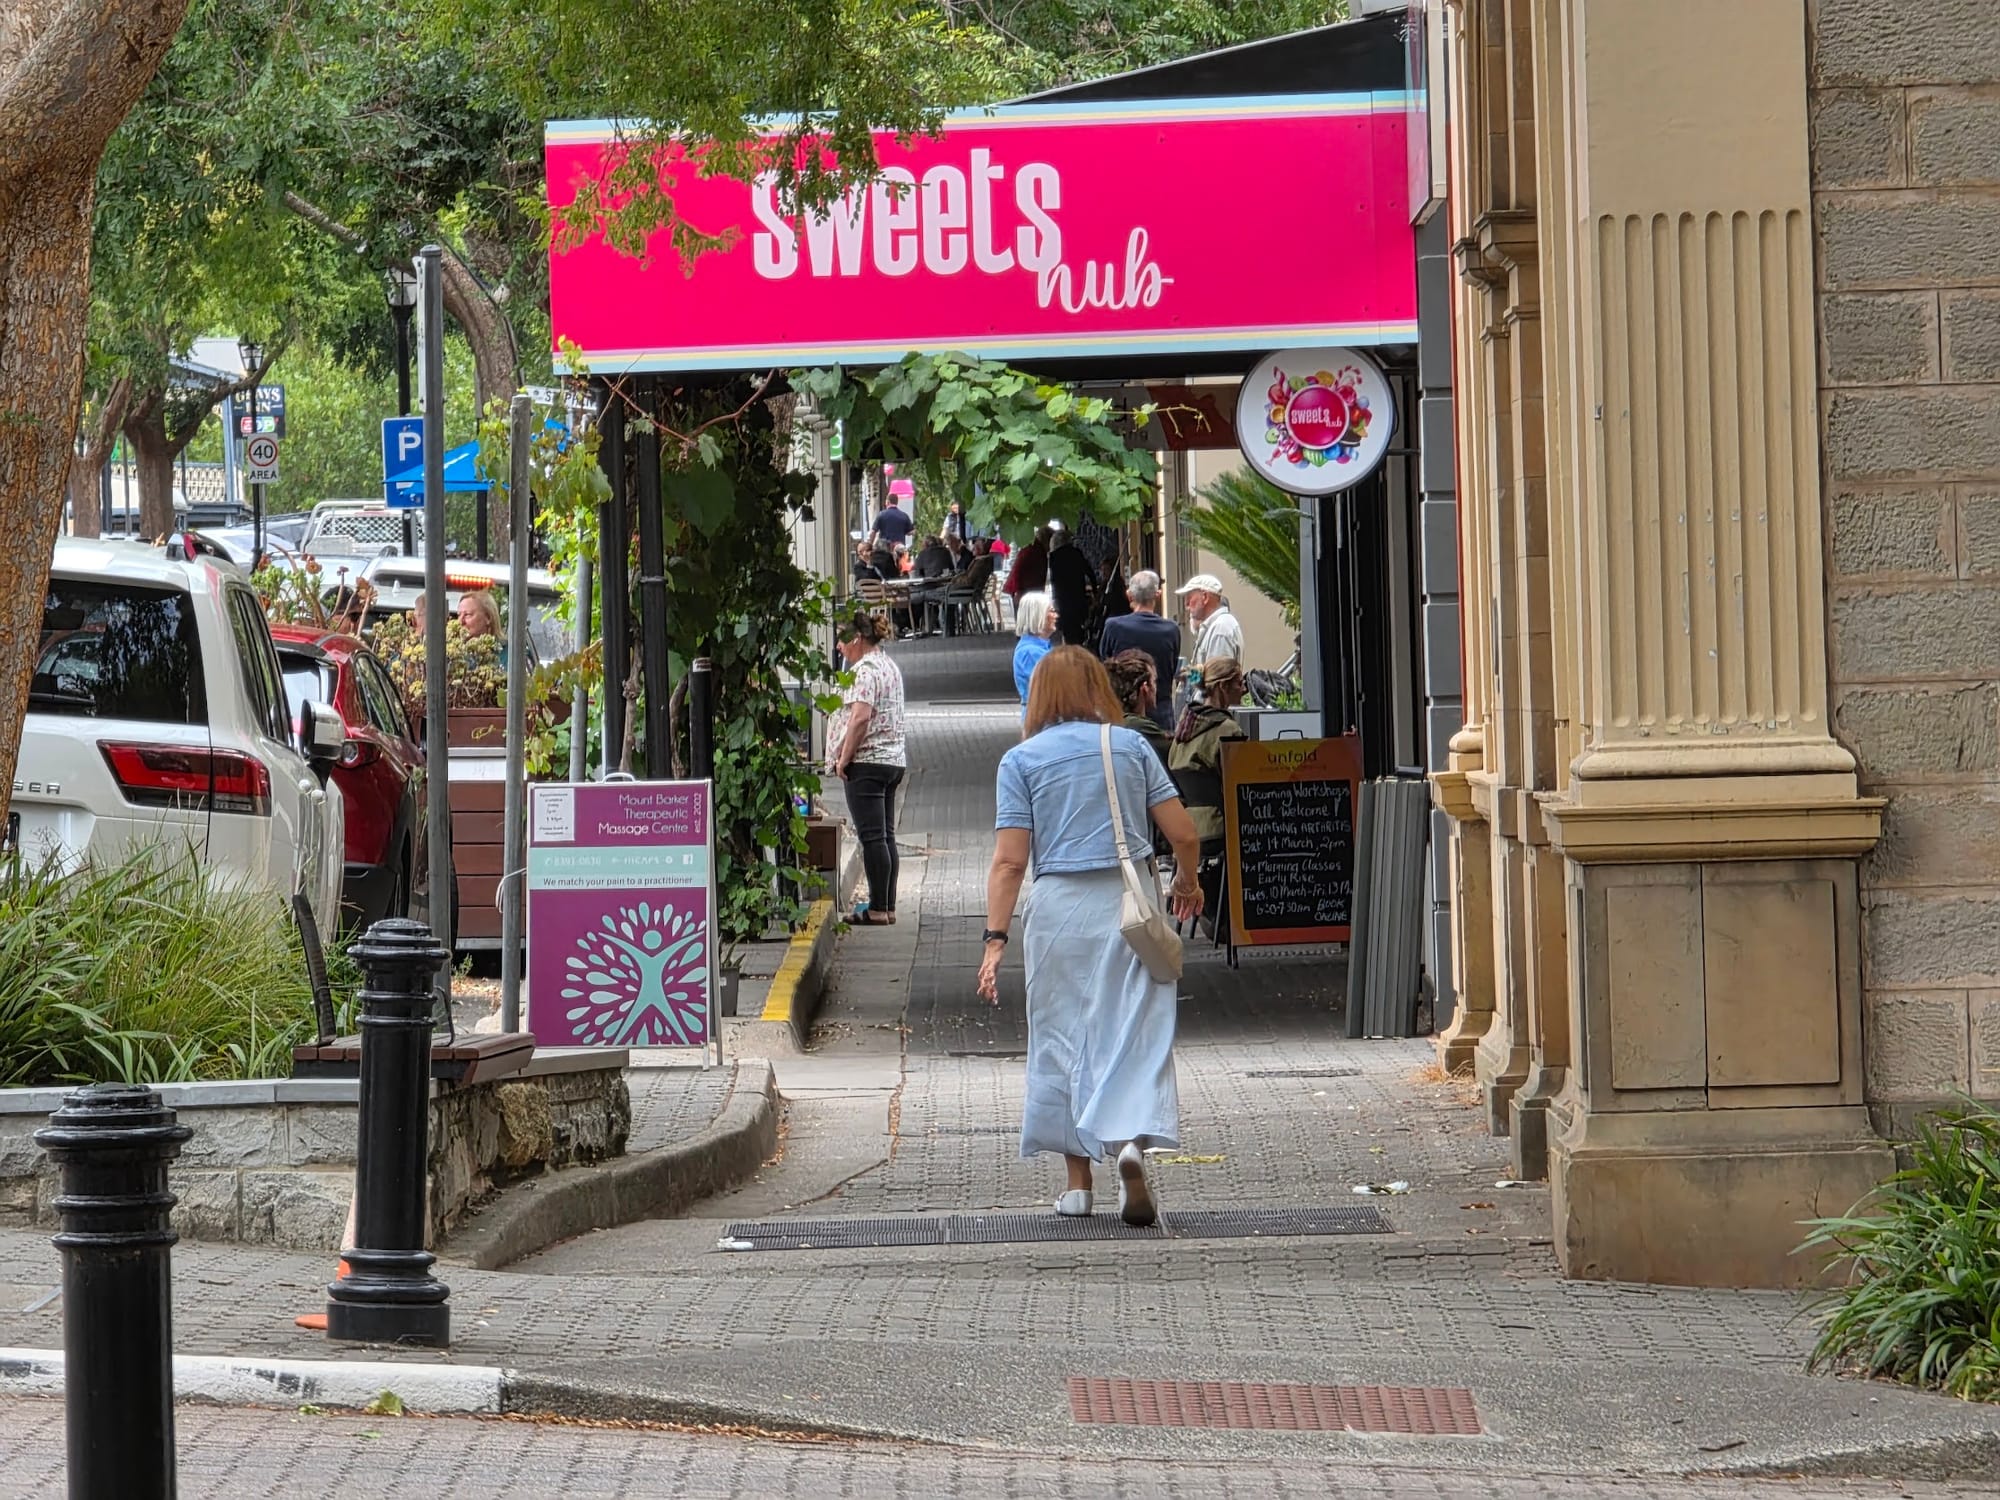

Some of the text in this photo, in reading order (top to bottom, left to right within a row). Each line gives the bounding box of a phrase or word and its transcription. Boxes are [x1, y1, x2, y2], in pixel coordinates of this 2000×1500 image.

[253, 445, 274, 459] 40
[398, 432, 421, 462] P
[249, 470, 277, 480] AREA
[1267, 750, 1317, 763] unfold
[619, 793, 689, 806] Mount Barker
[1240, 781, 1351, 807] Upcoming Workshops
[624, 808, 689, 821] Therapeutic
[598, 821, 689, 836] Massage Centre
[1241, 821, 1297, 835] MANAGING
[543, 878, 556, 886] We
[558, 877, 584, 886] match
[585, 879, 604, 888] your
[606, 878, 625, 887] pain
[644, 876, 693, 887] practitioner
